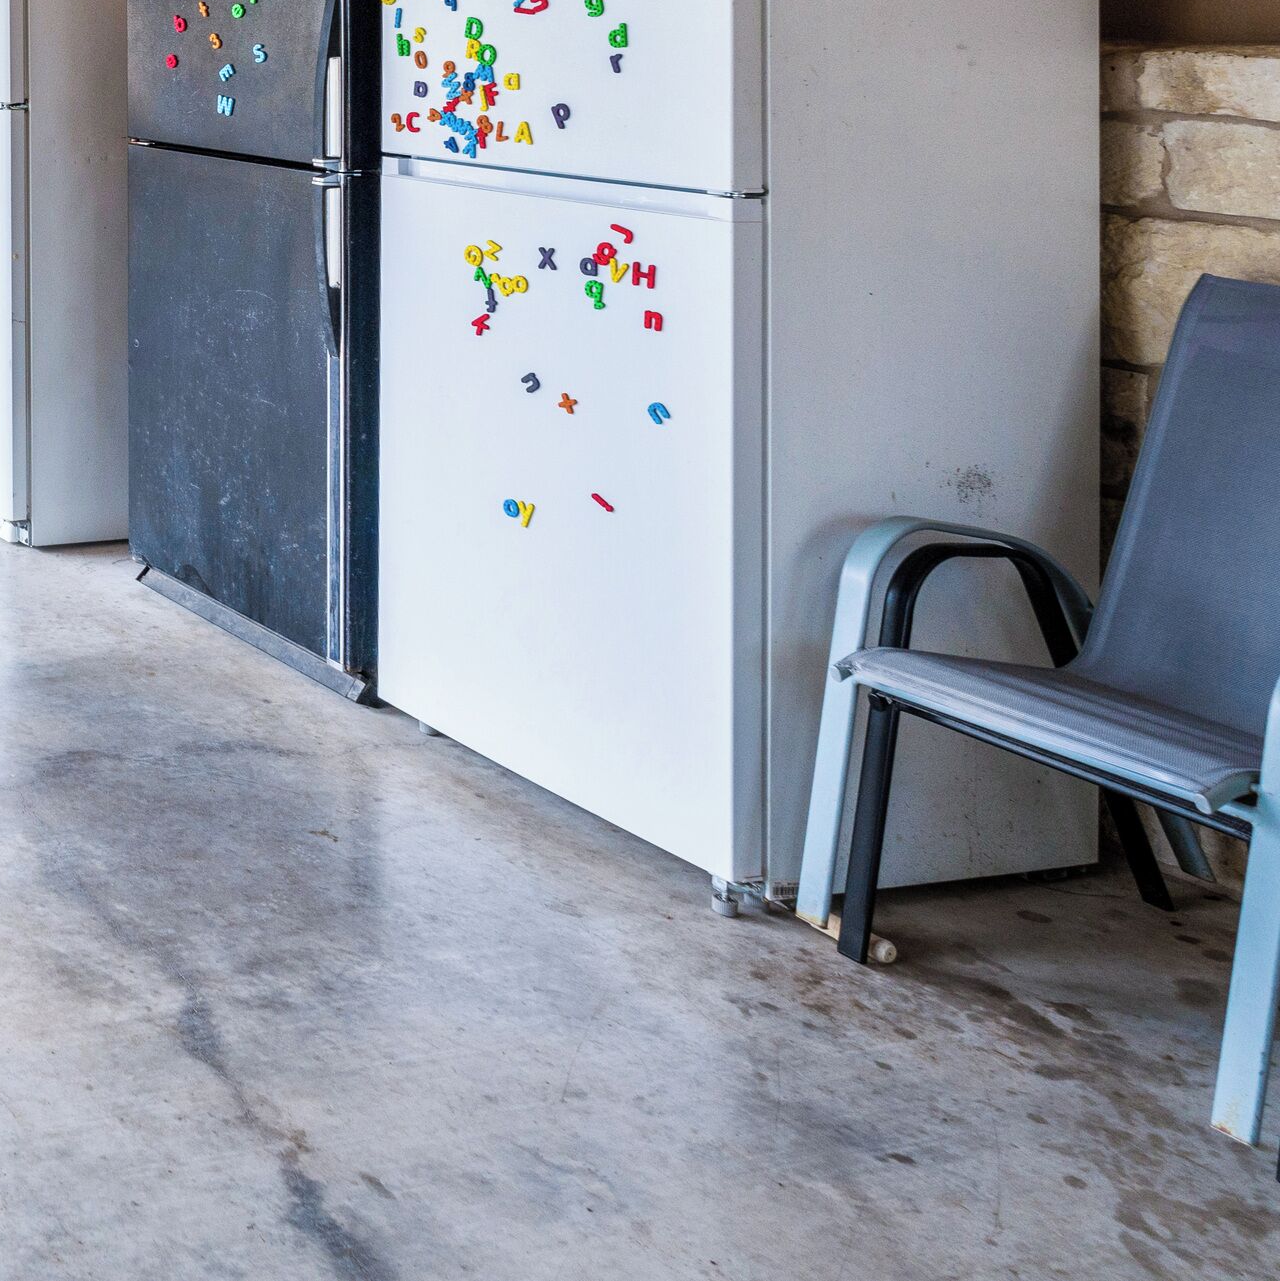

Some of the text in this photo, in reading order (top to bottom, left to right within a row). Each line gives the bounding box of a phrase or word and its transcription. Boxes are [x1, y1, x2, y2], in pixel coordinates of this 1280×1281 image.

[464, 17, 484, 41] D
[608, 23, 629, 48] d
[495, 121, 509, 142] L
[513, 121, 534, 145] A
[632, 261, 657, 290] H
